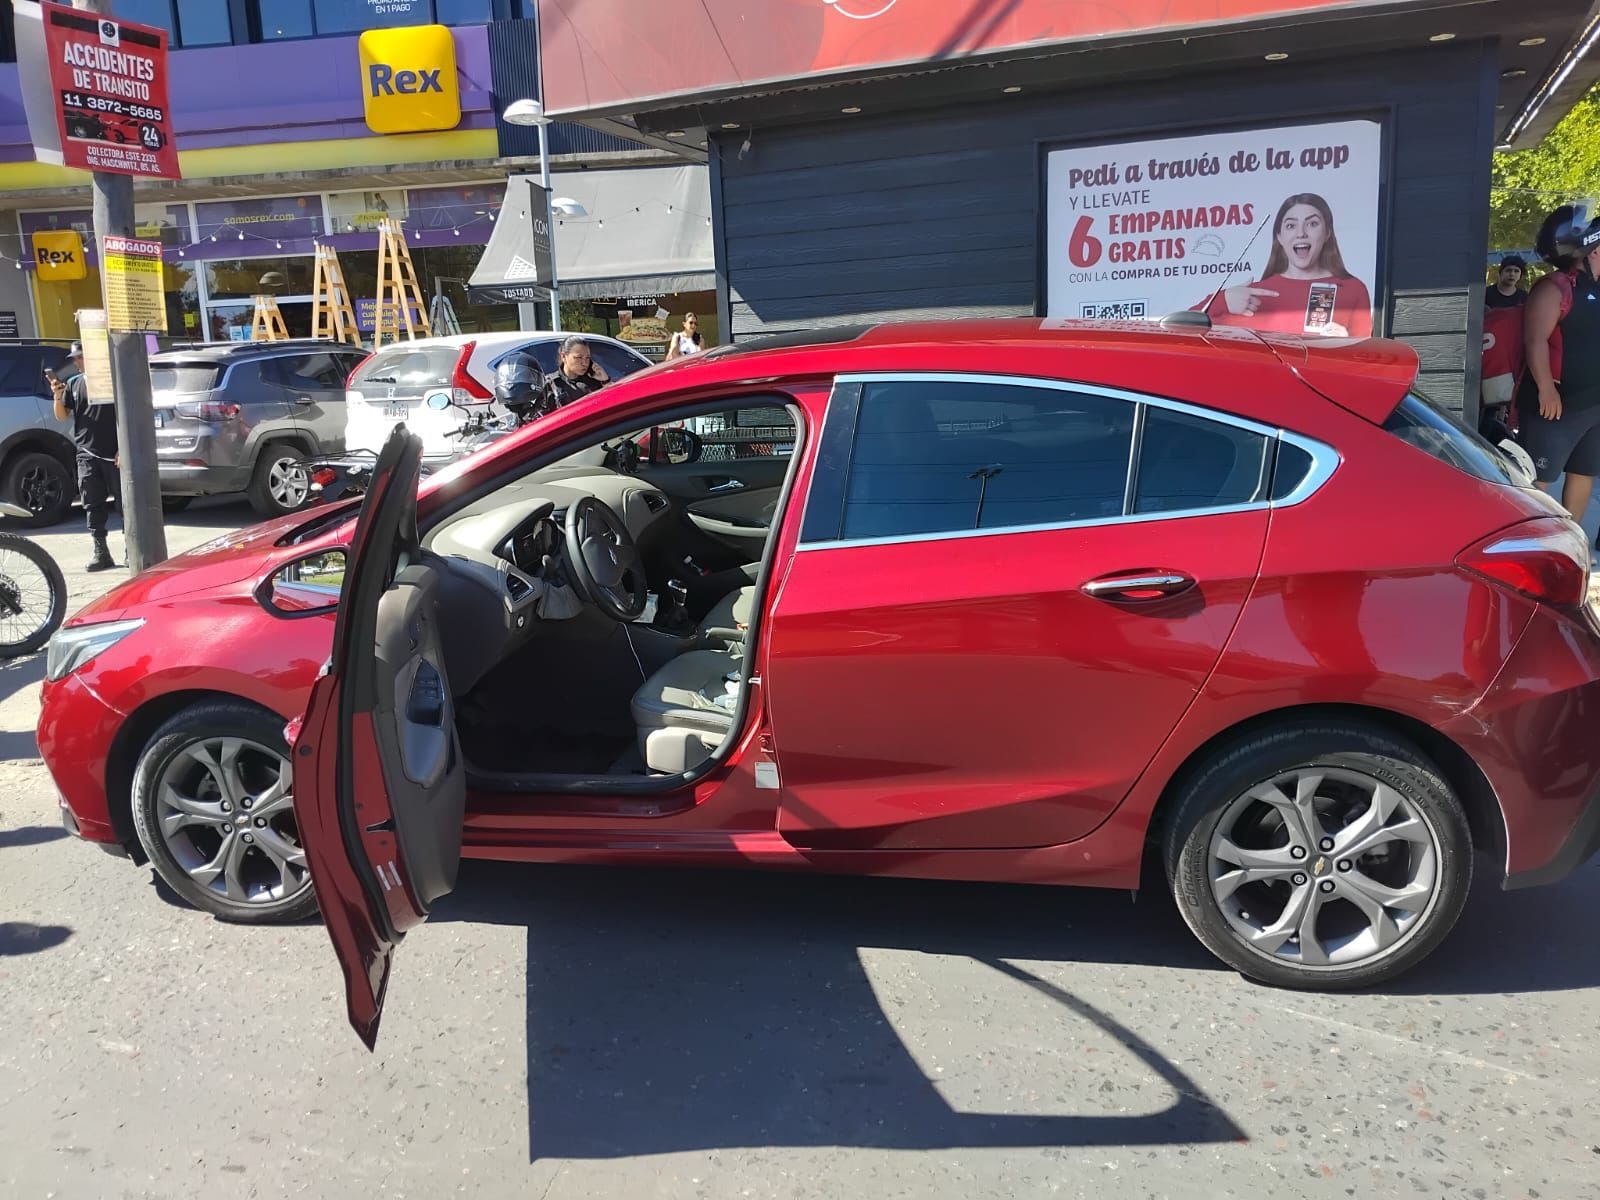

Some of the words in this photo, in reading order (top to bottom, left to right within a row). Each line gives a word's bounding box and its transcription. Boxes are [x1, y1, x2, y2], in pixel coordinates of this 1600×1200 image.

[392, 4, 411, 12] PAGO
[64, 41, 154, 81] ACCIDENTES
[73, 69, 91, 90] DE
[93, 72, 150, 101] TRANSITO
[369, 64, 443, 97] Rex
[64, 94, 82, 106] 11
[87, 97, 162, 120] 3872-5685
[142, 126, 158, 142] 24
[87, 146, 124, 159] COLECTORA
[125, 151, 140, 161] ESTE
[1069, 162, 1119, 189] Pedí
[1125, 165, 1143, 183] a
[1148, 152, 1220, 181] través
[1229, 150, 1260, 173] de
[1266, 148, 1294, 170] la
[1300, 145, 1349, 170] app
[1069, 196, 1079, 211] Y
[1083, 189, 1151, 209] LLEVATE
[224, 213, 295, 224] somosrex.com
[1068, 215, 1103, 268] 6
[1108, 203, 1254, 235] EMPANADAS
[37, 247, 75, 265] Rex
[105, 240, 161, 254] ABOGADOS
[1108, 238, 1186, 263] GRATIS
[1069, 272, 1092, 284] CON
[1095, 270, 1108, 282] LA
[1111, 268, 1161, 281] COMPRA
[1164, 266, 1179, 278] DE
[1182, 264, 1198, 276] TU
[1200, 261, 1252, 275] DOCENA
[502, 287, 534, 299] TOSTADO
